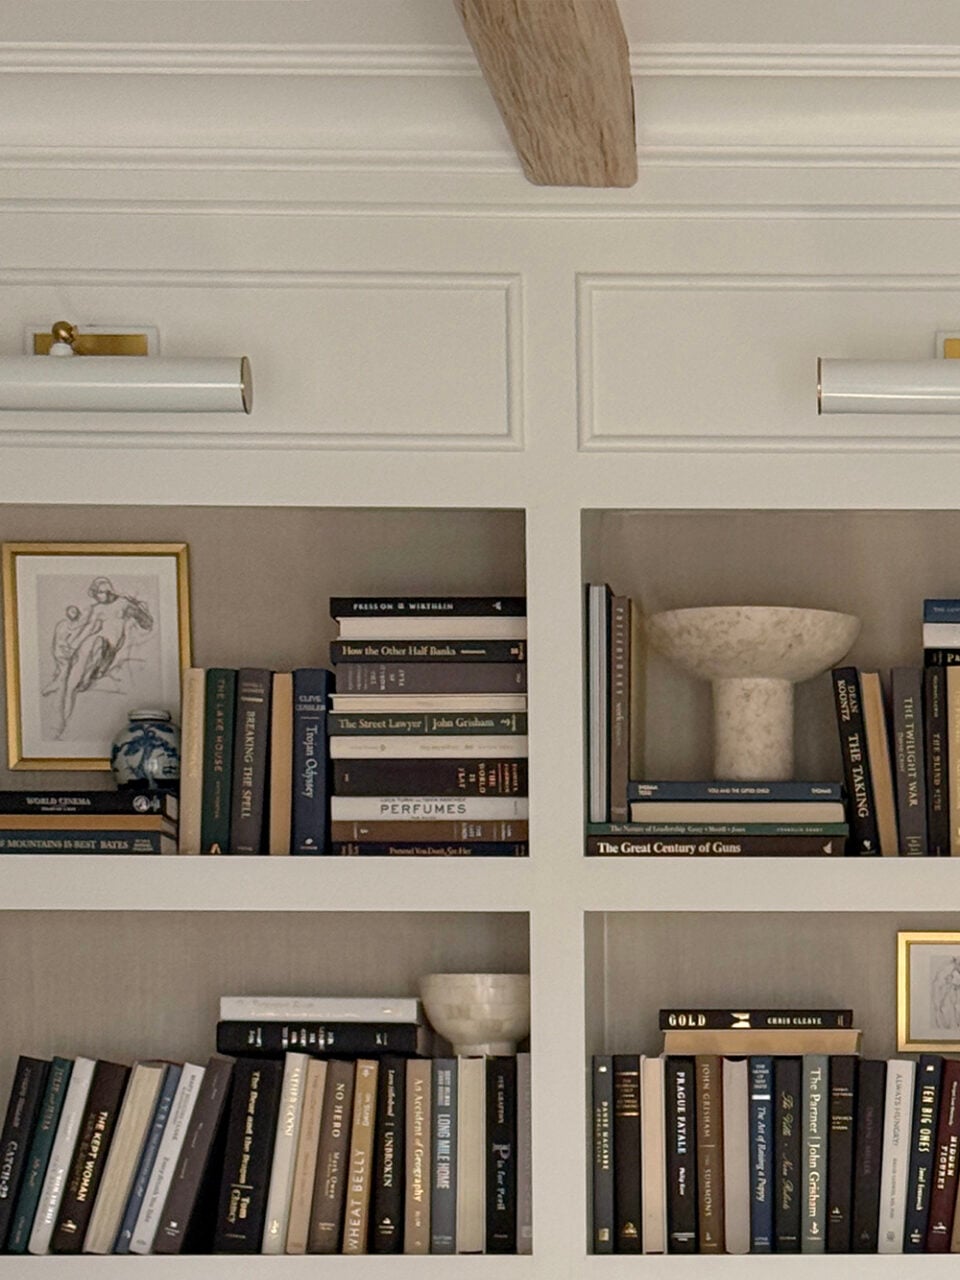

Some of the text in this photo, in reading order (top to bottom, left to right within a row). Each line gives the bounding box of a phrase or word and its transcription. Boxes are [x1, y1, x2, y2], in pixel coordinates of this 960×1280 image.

[342, 646, 457, 656] How the Other Half Banks
[215, 703, 225, 731] LAKE
[837, 679, 851, 721] KOONTZ
[847, 685, 858, 713] DEAN
[338, 718, 422, 731] The Street Lawyer
[432, 717, 495, 731] John Grisham
[214, 735, 225, 772] HOUSE
[241, 711, 256, 819] BREAKING THE SPELL
[301, 724, 318, 798] Trojan Odyssey
[904, 697, 918, 807] THE TWILIGHT WAR
[847, 733, 869, 818] THE TAKING
[26, 797, 91, 806] WORLD CINEMA
[380, 803, 467, 815] PERFUMES
[7, 840, 97, 849] MOUNTAINS IS BEST
[100, 840, 129, 849] BATES
[598, 842, 741, 856] The Great Century of Guns
[668, 1014, 706, 1026] GOLD
[767, 1016, 822, 1025] CHRIS CLEAVE
[332, 1083, 345, 1138] NO HERO
[676, 1071, 686, 1154] PRAGUE FATALE
[702, 1063, 711, 1138] JOHN GRISHAM
[808, 1067, 821, 1134] The Partner
[918, 1085, 935, 1153] TEN BIG ONES
[239, 1071, 260, 1184] The Bear and the Dragon
[412, 1077, 424, 1202] An Accident of Geography
[76, 1111, 108, 1202] THE KEPT WOMAN
[383, 1131, 394, 1187] UNBROKEN
[436, 1114, 451, 1189] LONG MILE HOME
[937, 1144, 948, 1190] FIGURES
[946, 1135, 958, 1176] HIDDEN
[348, 1149, 366, 1250] WHEAT BELLY
[703, 1168, 712, 1217] SUMMONS
[808, 1142, 821, 1218] John Grisham
[226, 1189, 241, 1223] Clancy
[239, 1197, 250, 1219] Tom
